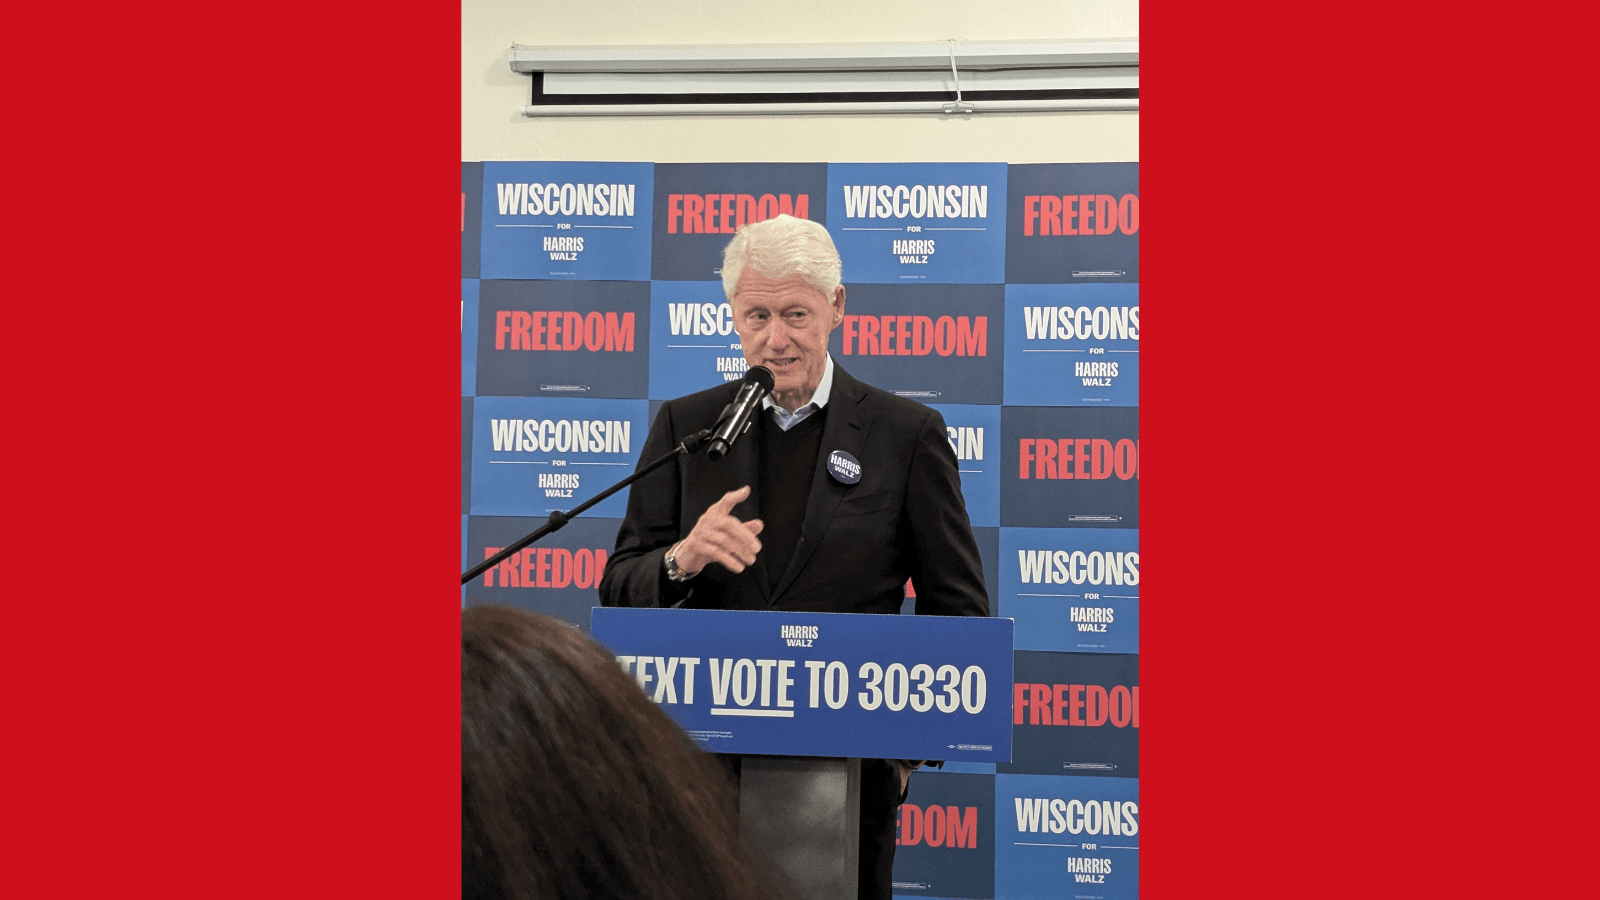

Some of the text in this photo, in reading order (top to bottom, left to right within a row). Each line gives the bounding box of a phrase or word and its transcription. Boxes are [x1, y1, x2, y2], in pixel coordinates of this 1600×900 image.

[497, 183, 635, 216] WISCONSIN
[844, 185, 987, 218] WISCONSIN
[668, 194, 808, 233] FREEDOM
[1024, 194, 1138, 236] FREEDO
[906, 225, 922, 233] FOR
[543, 236, 585, 252] HARRIS
[892, 239, 935, 255] HARRIS
[549, 252, 578, 261] WALZ
[899, 255, 929, 264] WALZ
[496, 311, 634, 351] FREEDOM
[843, 315, 987, 356] FREEDOM
[1089, 347, 1105, 355] FOR
[1074, 361, 1119, 378] HARRIS
[1081, 377, 1112, 387] WALZ
[491, 419, 630, 453] WISCONSIN
[552, 459, 567, 467] FOR
[830, 454, 861, 475] HARRIS
[1020, 439, 1138, 480] FREEDO
[834, 465, 855, 478] WALZ
[538, 473, 580, 489] HARRIS
[544, 488, 573, 498] WALZ
[1019, 550, 1138, 586] WISCONS
[1084, 592, 1100, 600] FOR
[1070, 606, 1114, 624] HARRIS
[781, 625, 819, 640] HARRIS
[1077, 623, 1107, 633] WALZ
[787, 639, 813, 648] WALZ
[709, 657, 795, 708] VOTE
[805, 661, 848, 709] TO
[859, 662, 986, 714] 30330
[1014, 684, 1138, 728] FREEDO
[1015, 798, 1138, 836] WISCONS
[1067, 857, 1112, 875] HARRIS
[1074, 874, 1105, 884] WALZ
